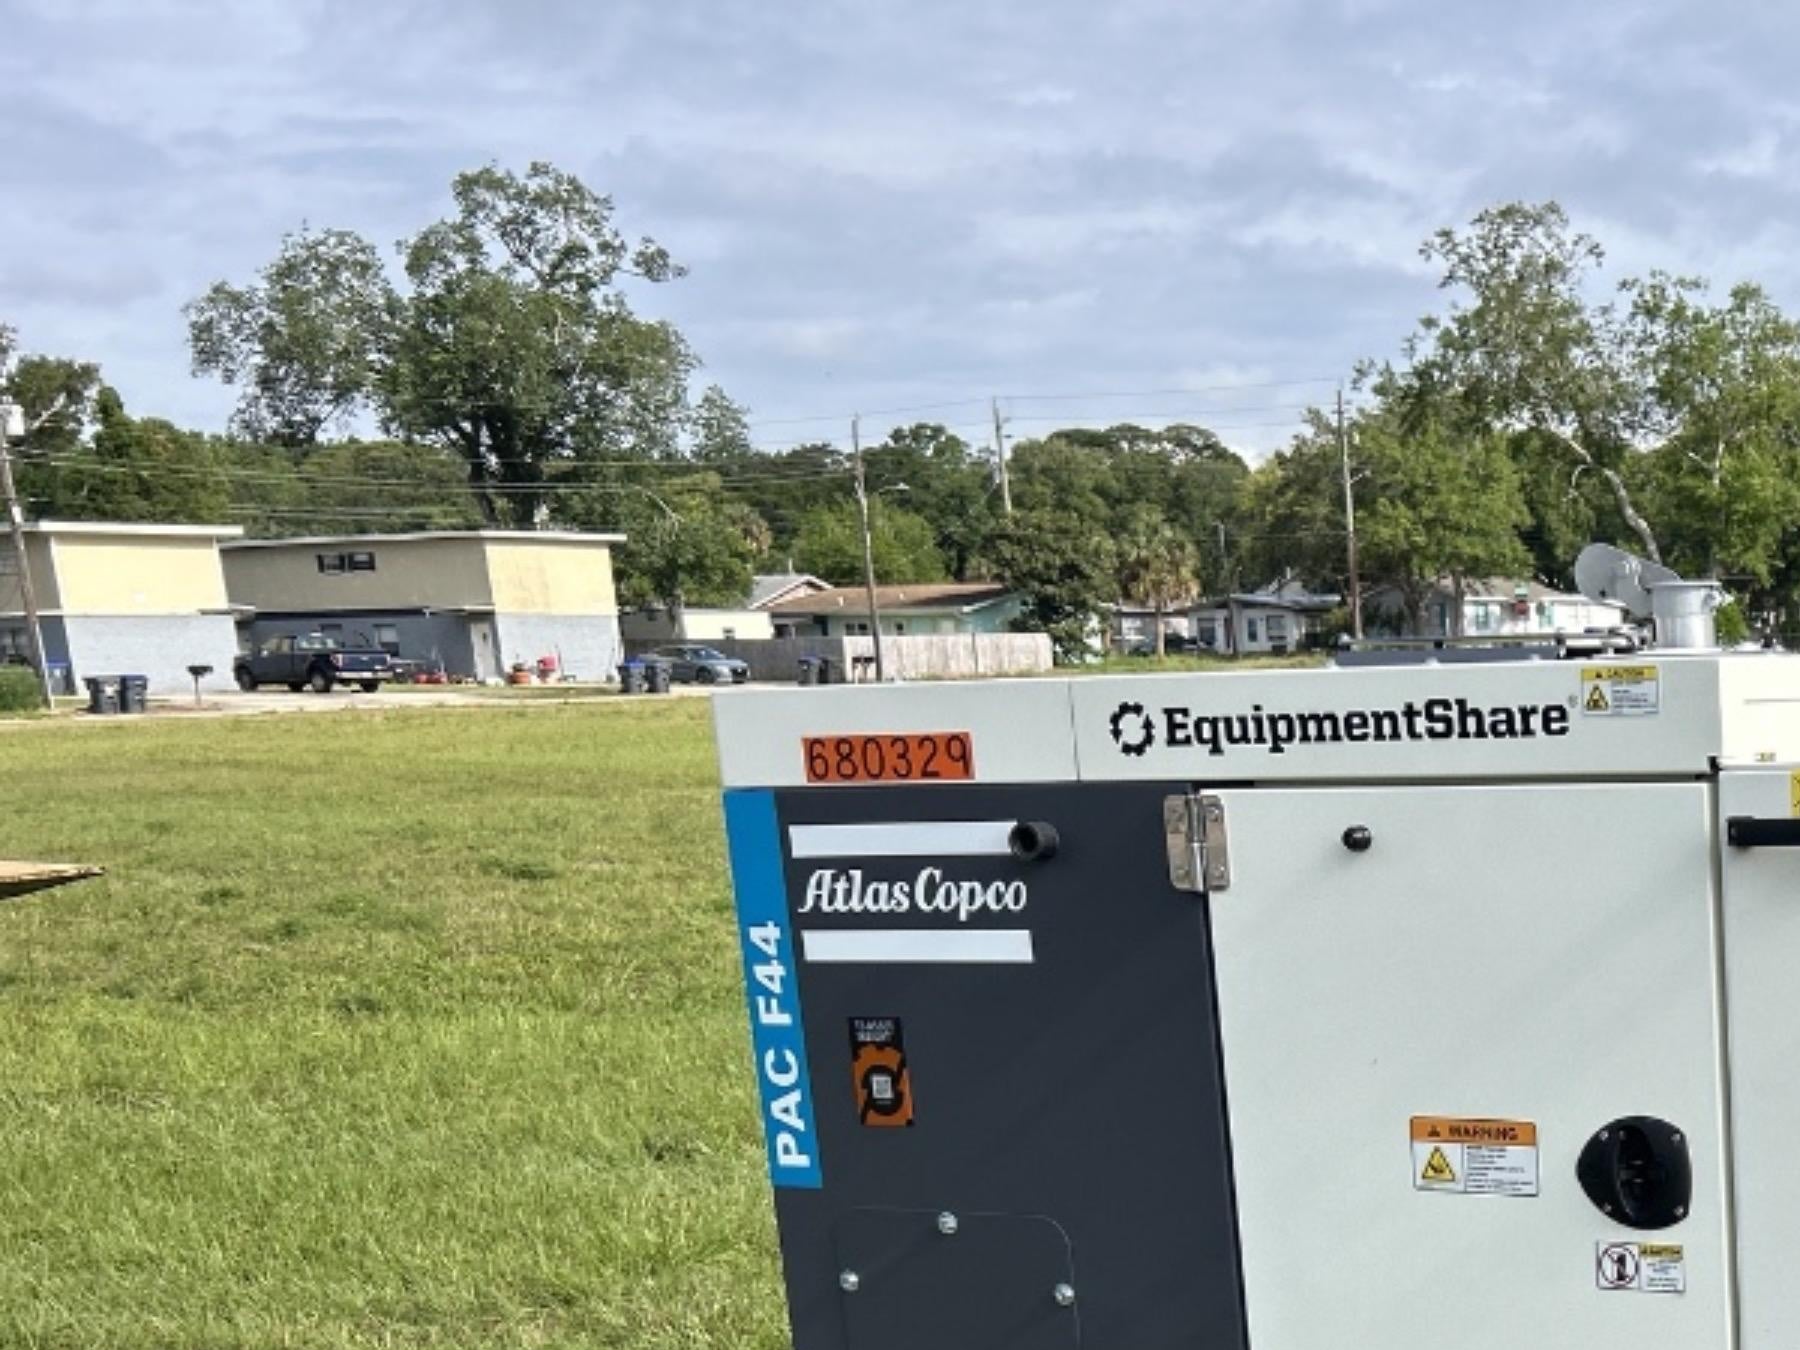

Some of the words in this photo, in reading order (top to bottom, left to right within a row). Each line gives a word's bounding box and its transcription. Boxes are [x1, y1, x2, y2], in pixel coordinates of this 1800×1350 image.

[1163, 698, 1570, 755] EquipmentShare
[807, 735, 971, 781] 680329
[798, 867, 910, 914] Atlas
[914, 866, 1027, 922] Copco
[749, 920, 793, 1027] F44
[764, 1048, 811, 1169] PAC
[1449, 1125, 1519, 1141] WARNING
